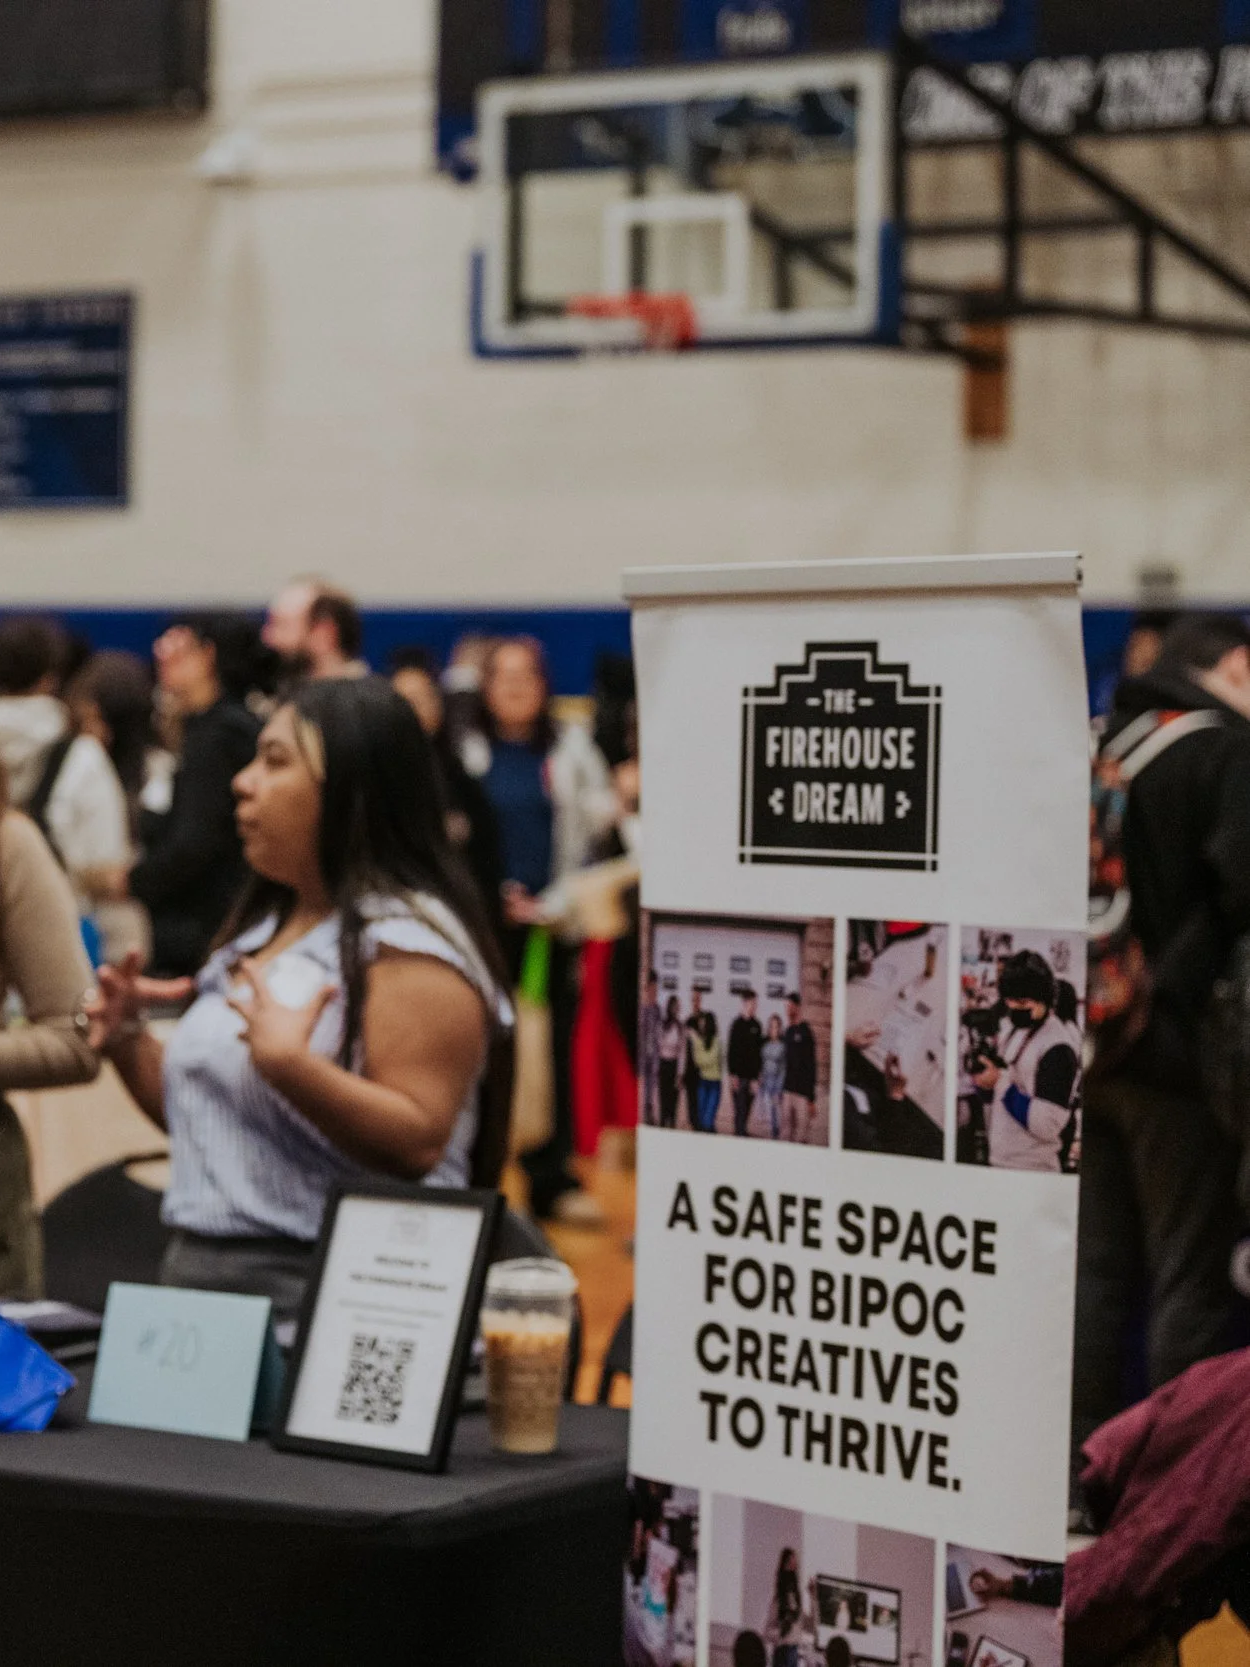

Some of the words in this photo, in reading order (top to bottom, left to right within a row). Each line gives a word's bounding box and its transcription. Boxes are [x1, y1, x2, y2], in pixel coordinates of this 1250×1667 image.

[824, 689, 855, 713] THE
[766, 727, 915, 769] FIREHOUSE
[794, 782, 883, 824] DREAM
[667, 1180, 699, 1233] A
[712, 1186, 821, 1249] SAFE
[838, 1202, 996, 1275] SPACE
[705, 1254, 795, 1316] FOR
[811, 1270, 964, 1343] BIPOC
[696, 1323, 958, 1416] CREATIVES
[700, 1391, 764, 1449] TO
[777, 1405, 960, 1491] THRIVE.
